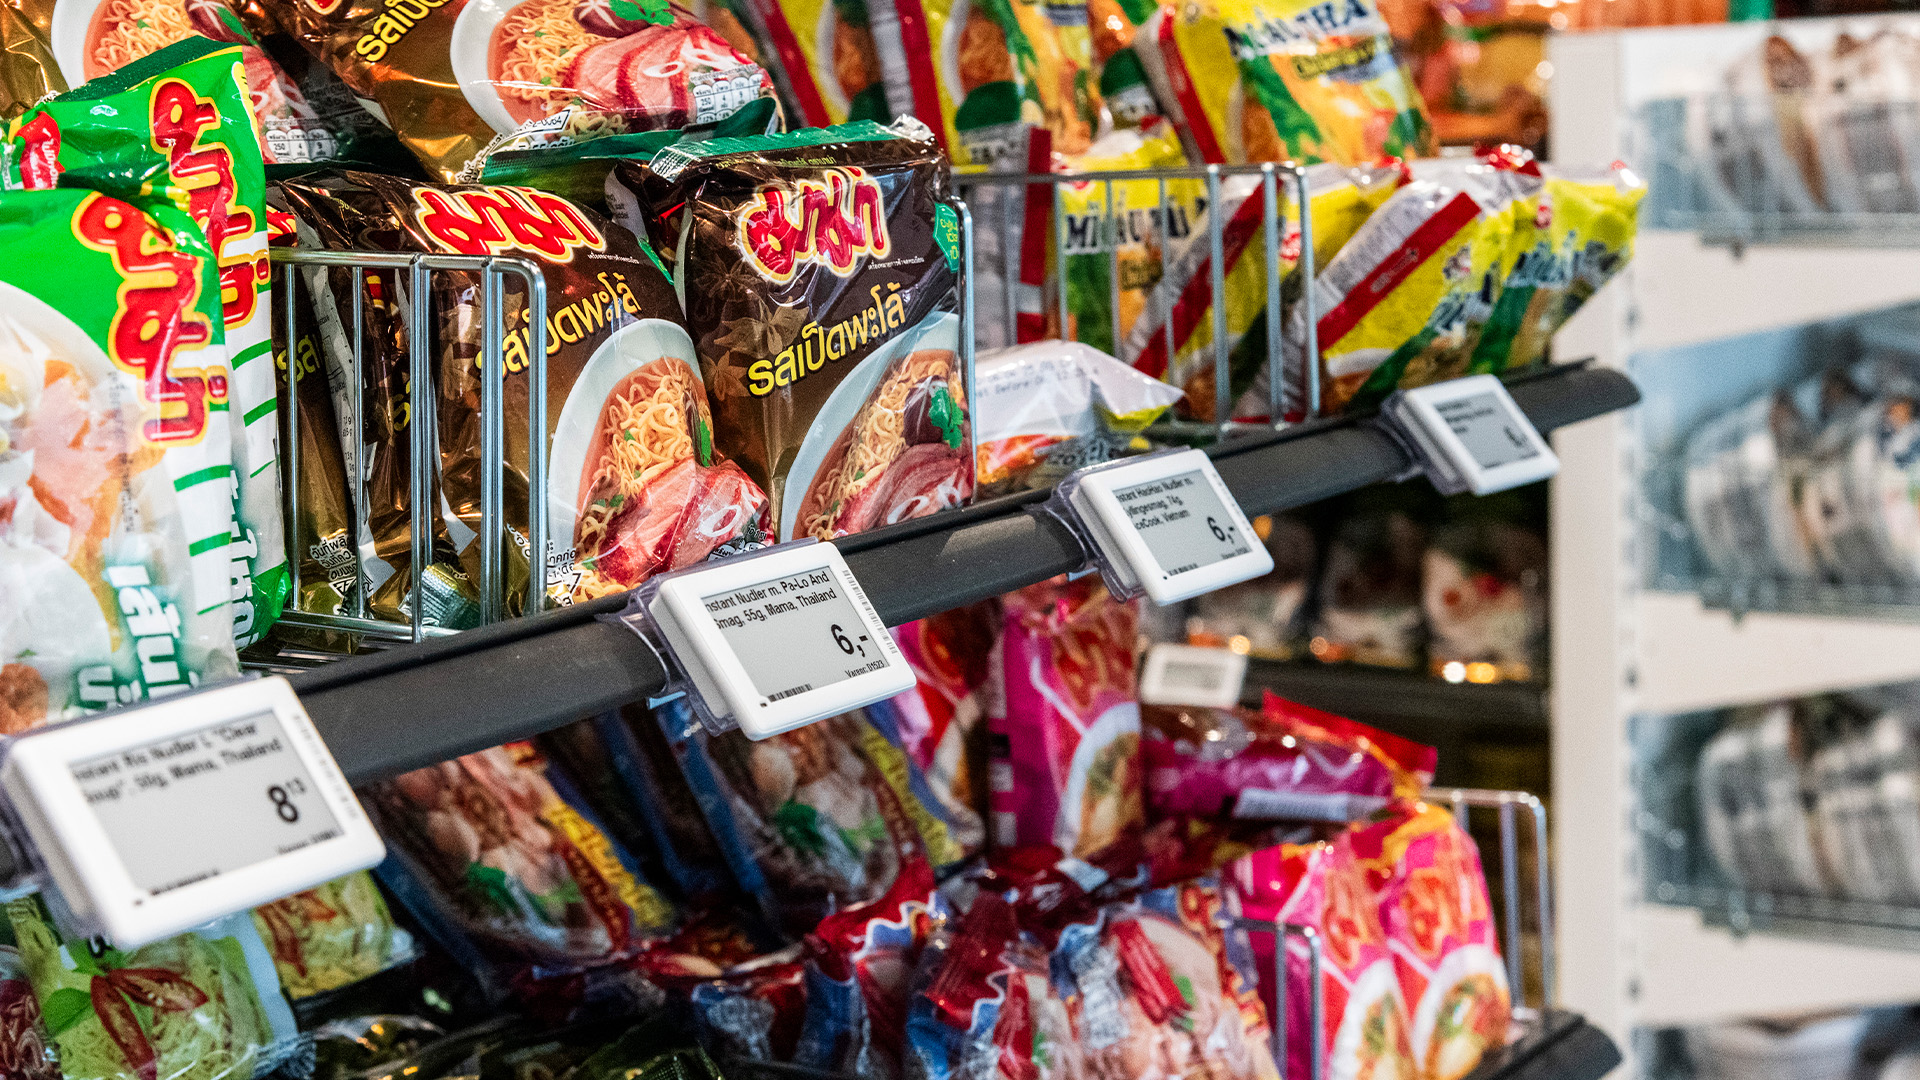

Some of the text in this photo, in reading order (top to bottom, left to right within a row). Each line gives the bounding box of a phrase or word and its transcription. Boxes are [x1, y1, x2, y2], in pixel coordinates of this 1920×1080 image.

[415, 186, 605, 260] มาม่า
[742, 166, 890, 282] มาม่า
[748, 282, 907, 397] รสเป็ดพะโล้
[705, 570, 830, 613] nstant Nudler m. Pa-Lo And
[743, 608, 768, 622] 55g,
[764, 601, 798, 616] Mama,
[795, 587, 838, 608] Thailand
